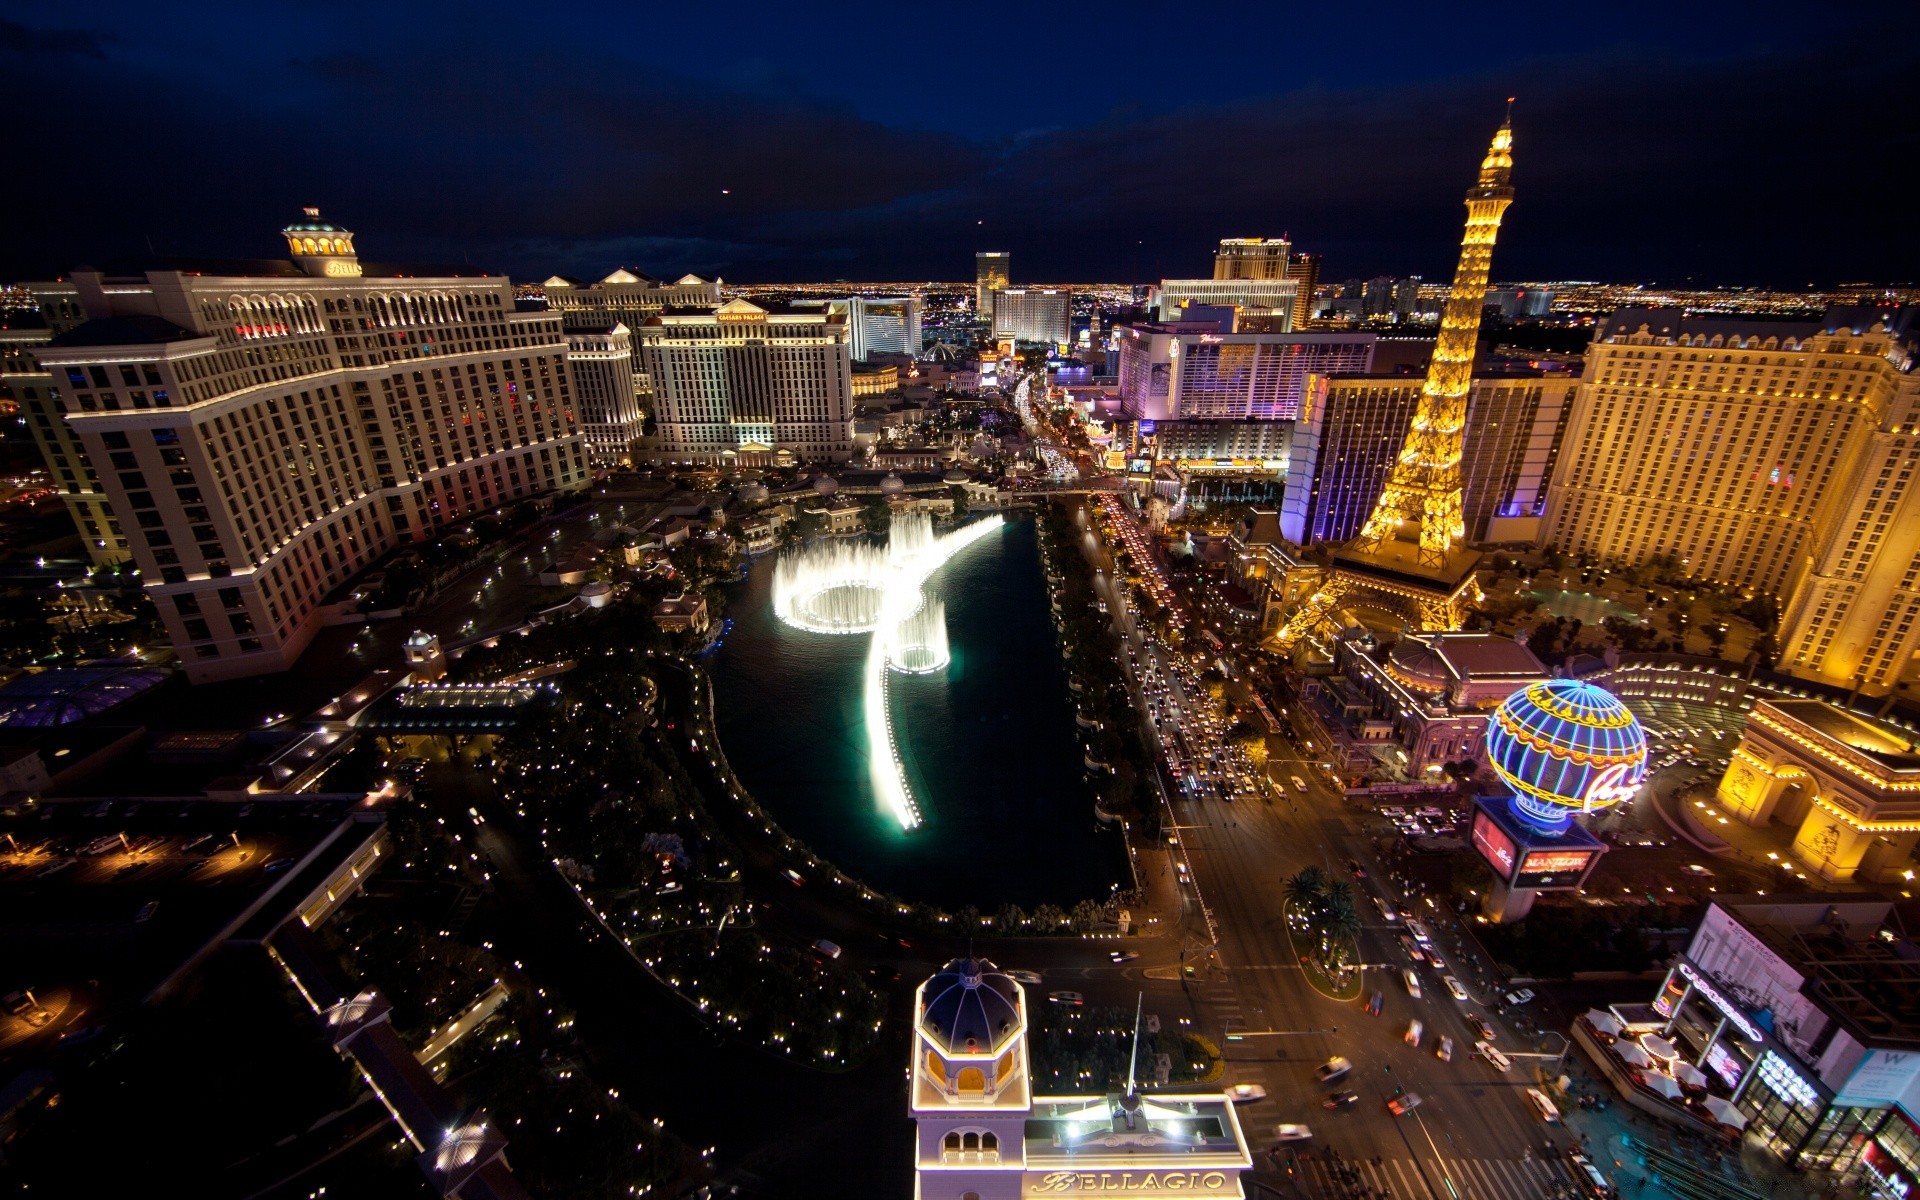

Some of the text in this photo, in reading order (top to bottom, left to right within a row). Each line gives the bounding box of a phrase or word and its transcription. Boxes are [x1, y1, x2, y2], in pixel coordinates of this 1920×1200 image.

[1583, 763, 1643, 813] Paris
[1766, 1049, 1819, 1100] URBAN
[1884, 1052, 1908, 1065] W
[1757, 1066, 1794, 1104] TERS
[1031, 1171, 1226, 1193] BELLAGIO
